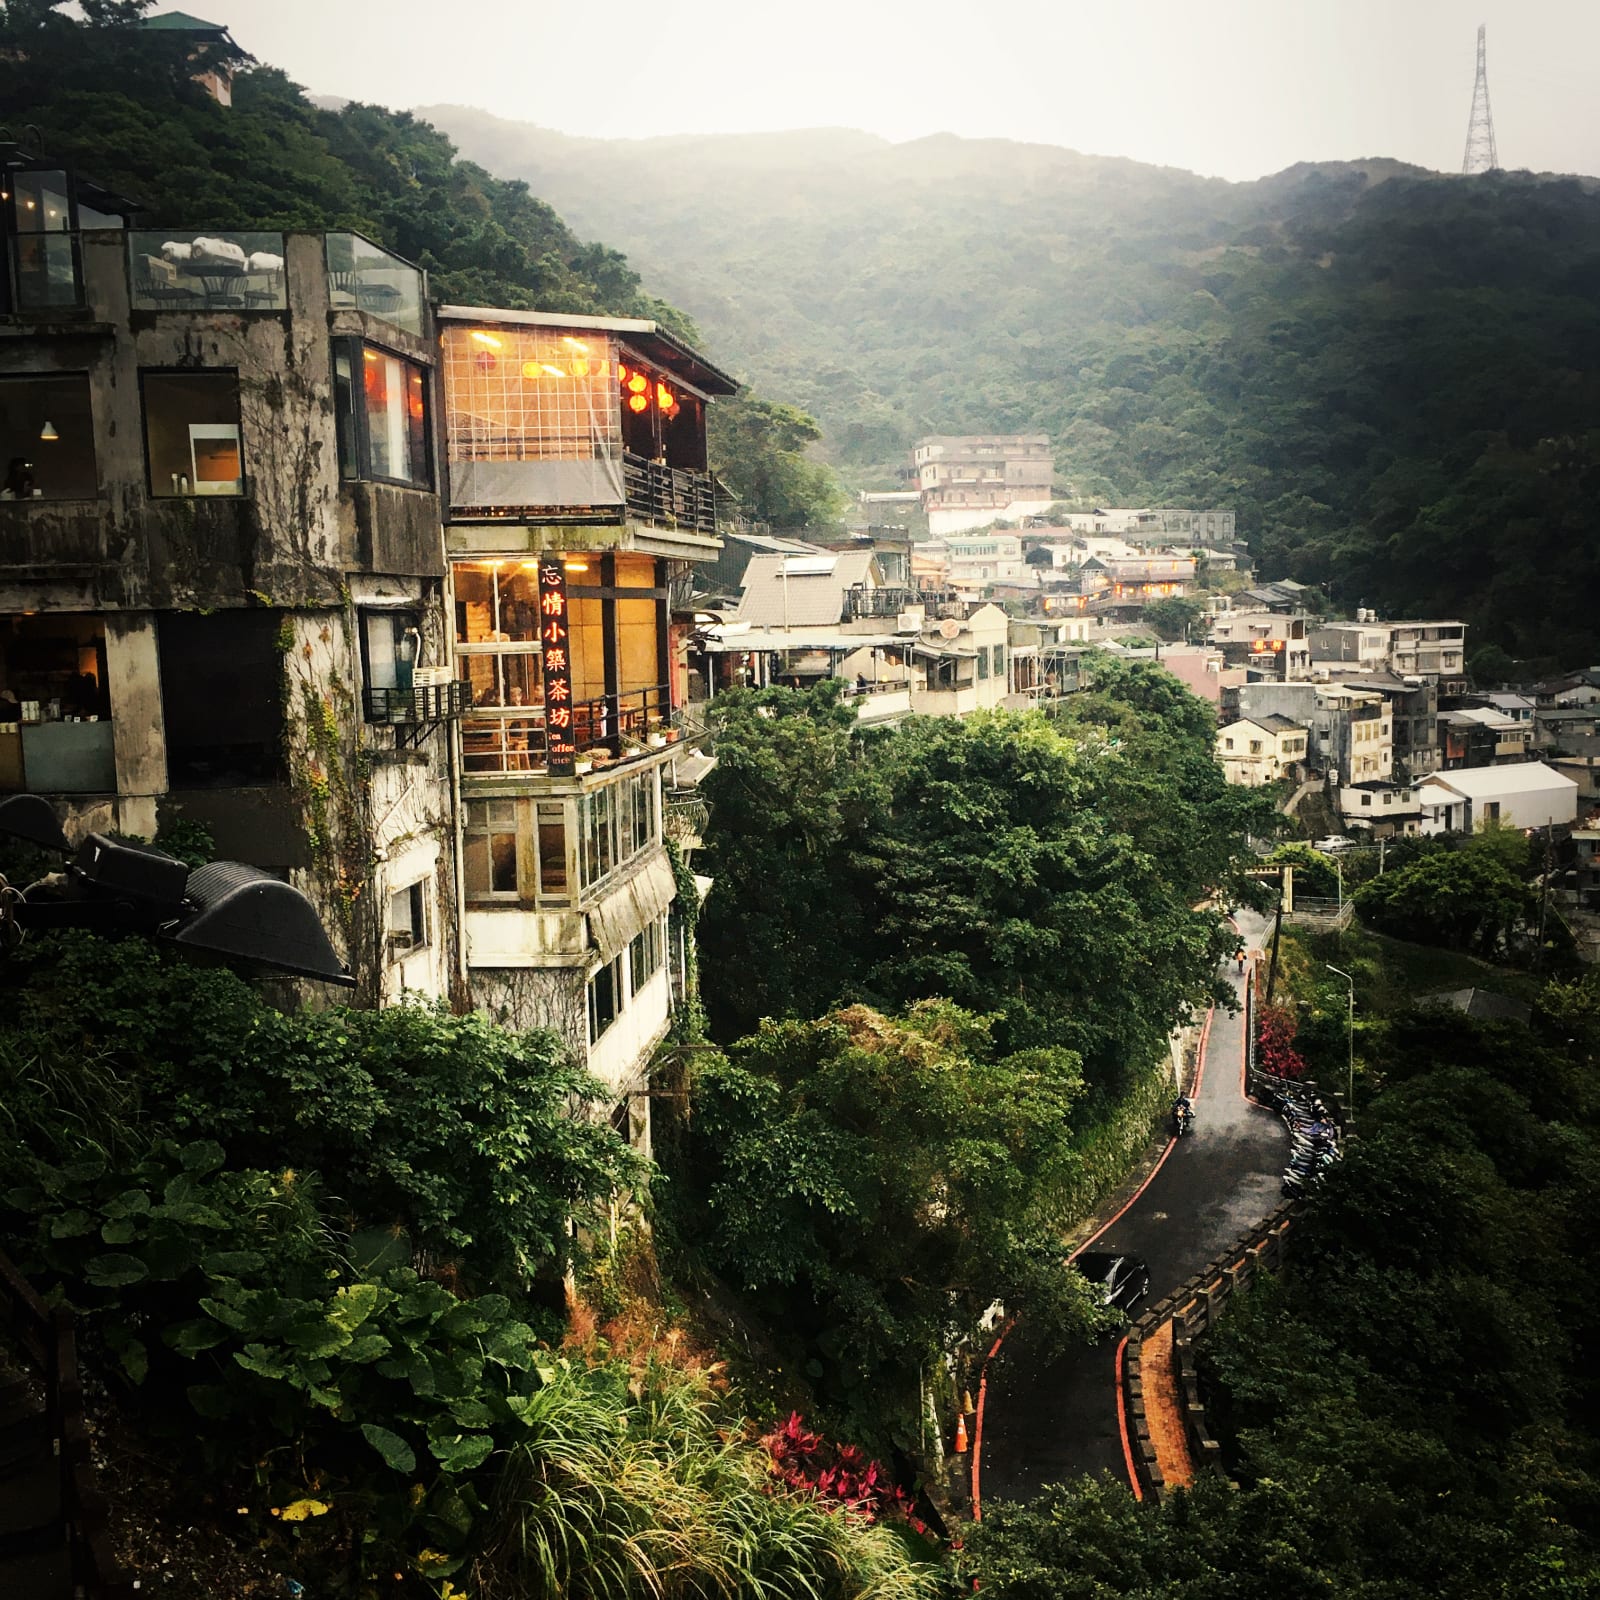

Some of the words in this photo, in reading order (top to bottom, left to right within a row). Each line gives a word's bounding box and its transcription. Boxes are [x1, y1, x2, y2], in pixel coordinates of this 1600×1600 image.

[542, 564, 570, 728] 忘情小築茶坊
[549, 743, 575, 753] offee
